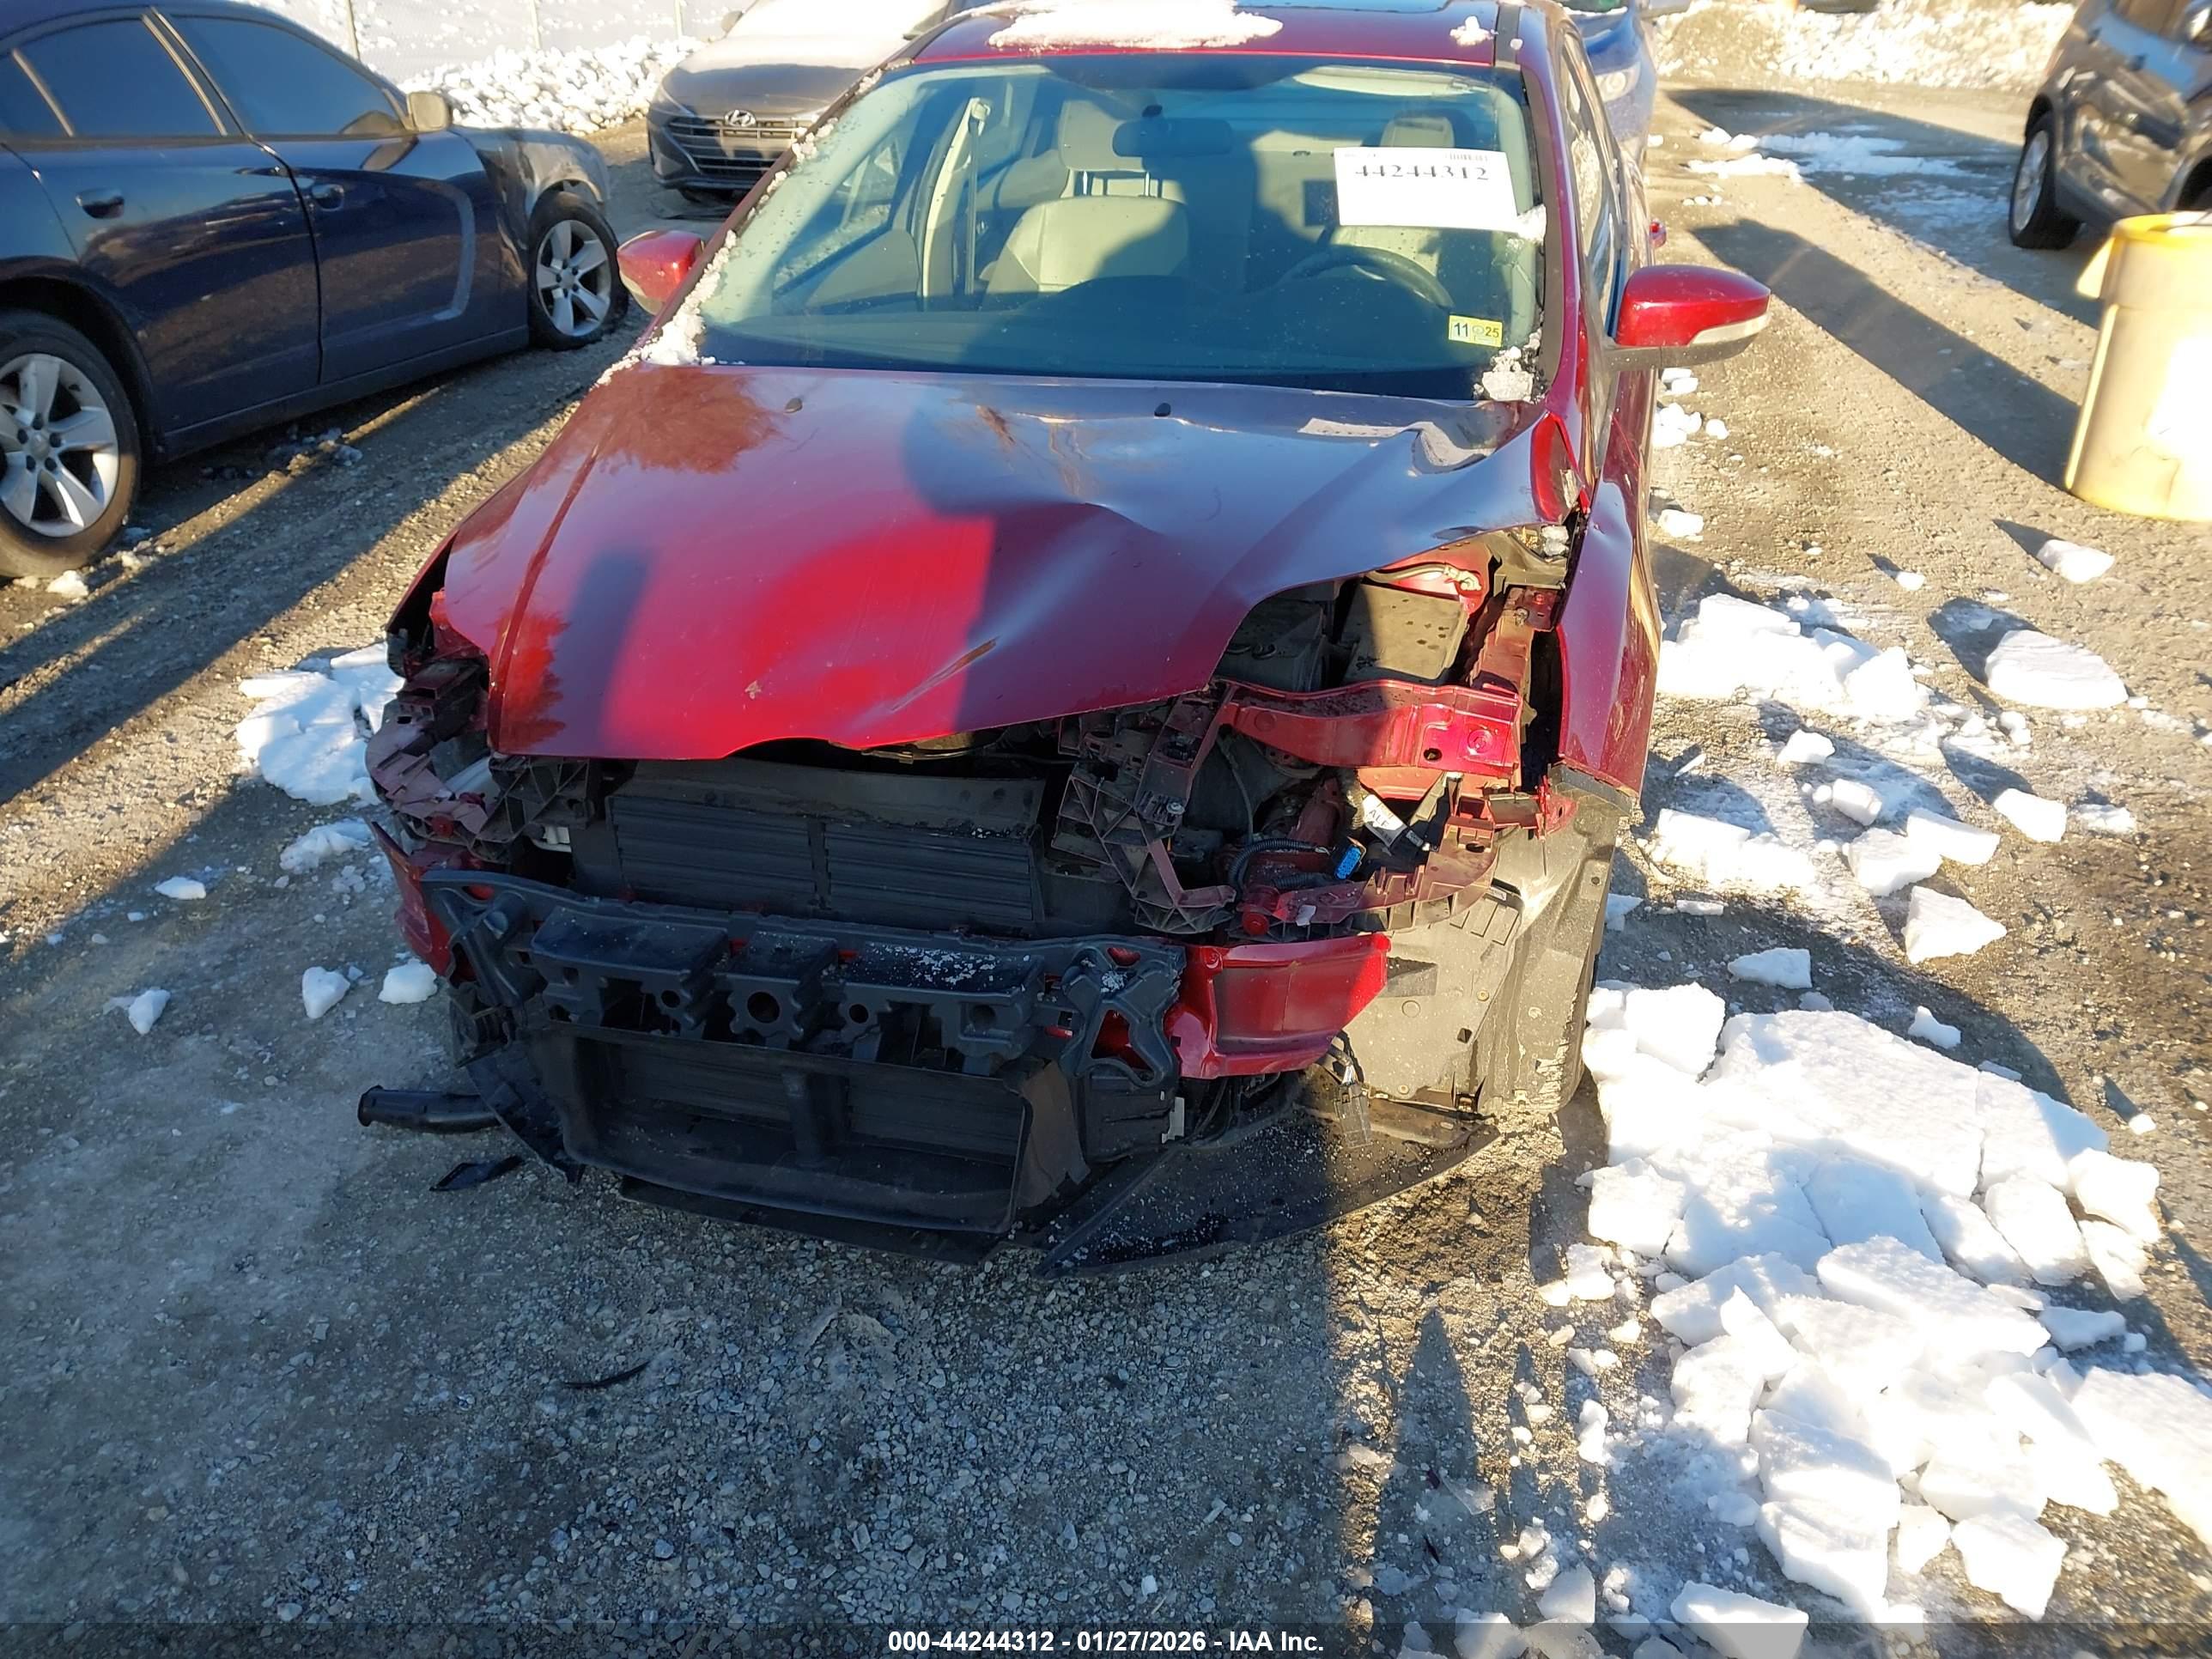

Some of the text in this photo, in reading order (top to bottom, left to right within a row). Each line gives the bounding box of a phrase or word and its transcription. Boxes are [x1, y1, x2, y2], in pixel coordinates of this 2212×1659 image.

[1355, 164, 1489, 180] 44244312
[1454, 322, 1499, 337] 11 25
